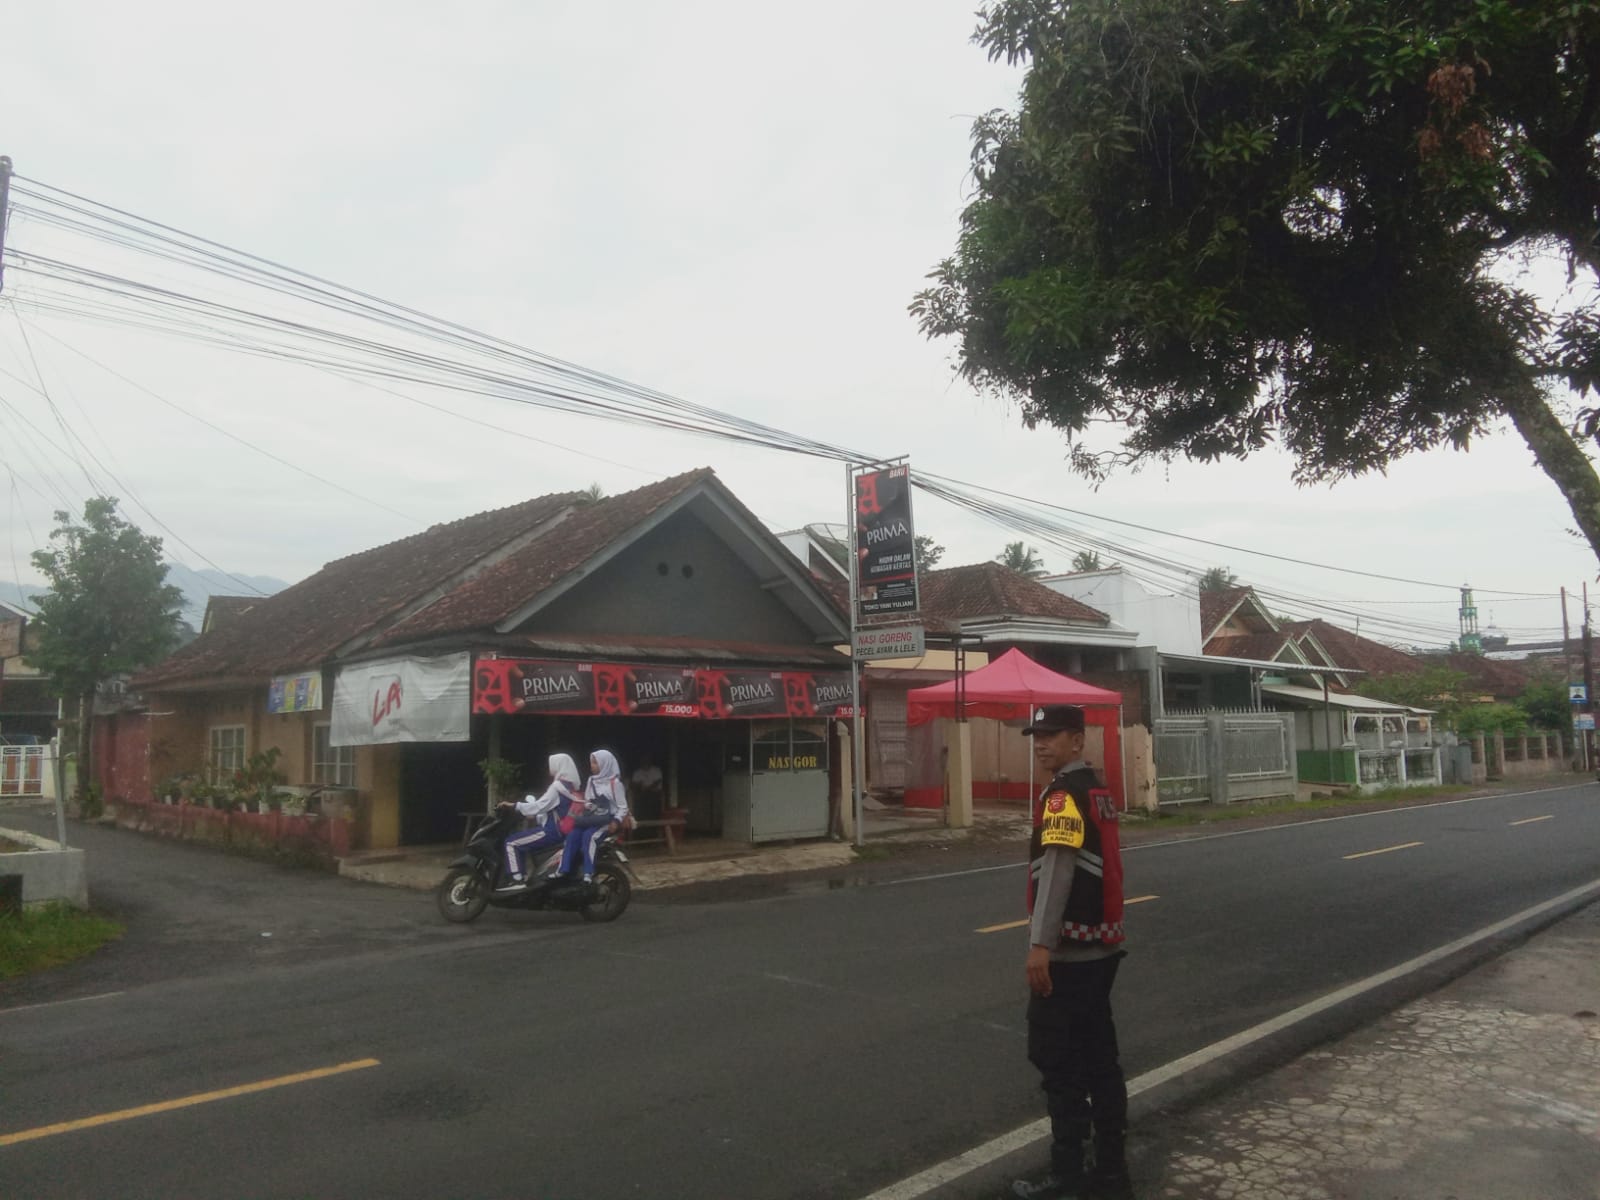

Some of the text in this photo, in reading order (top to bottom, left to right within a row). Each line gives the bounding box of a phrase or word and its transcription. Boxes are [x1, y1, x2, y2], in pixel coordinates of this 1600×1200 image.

[867, 522, 908, 545] PRIMA
[858, 631, 912, 646] NASI GORENG
[856, 647, 874, 656] PECEL
[900, 643, 916, 653] LELE
[523, 675, 581, 696] PRIMA
[636, 680, 684, 698] PRIMA
[730, 683, 775, 701] PRIMA
[816, 685, 853, 701] PRIMA
